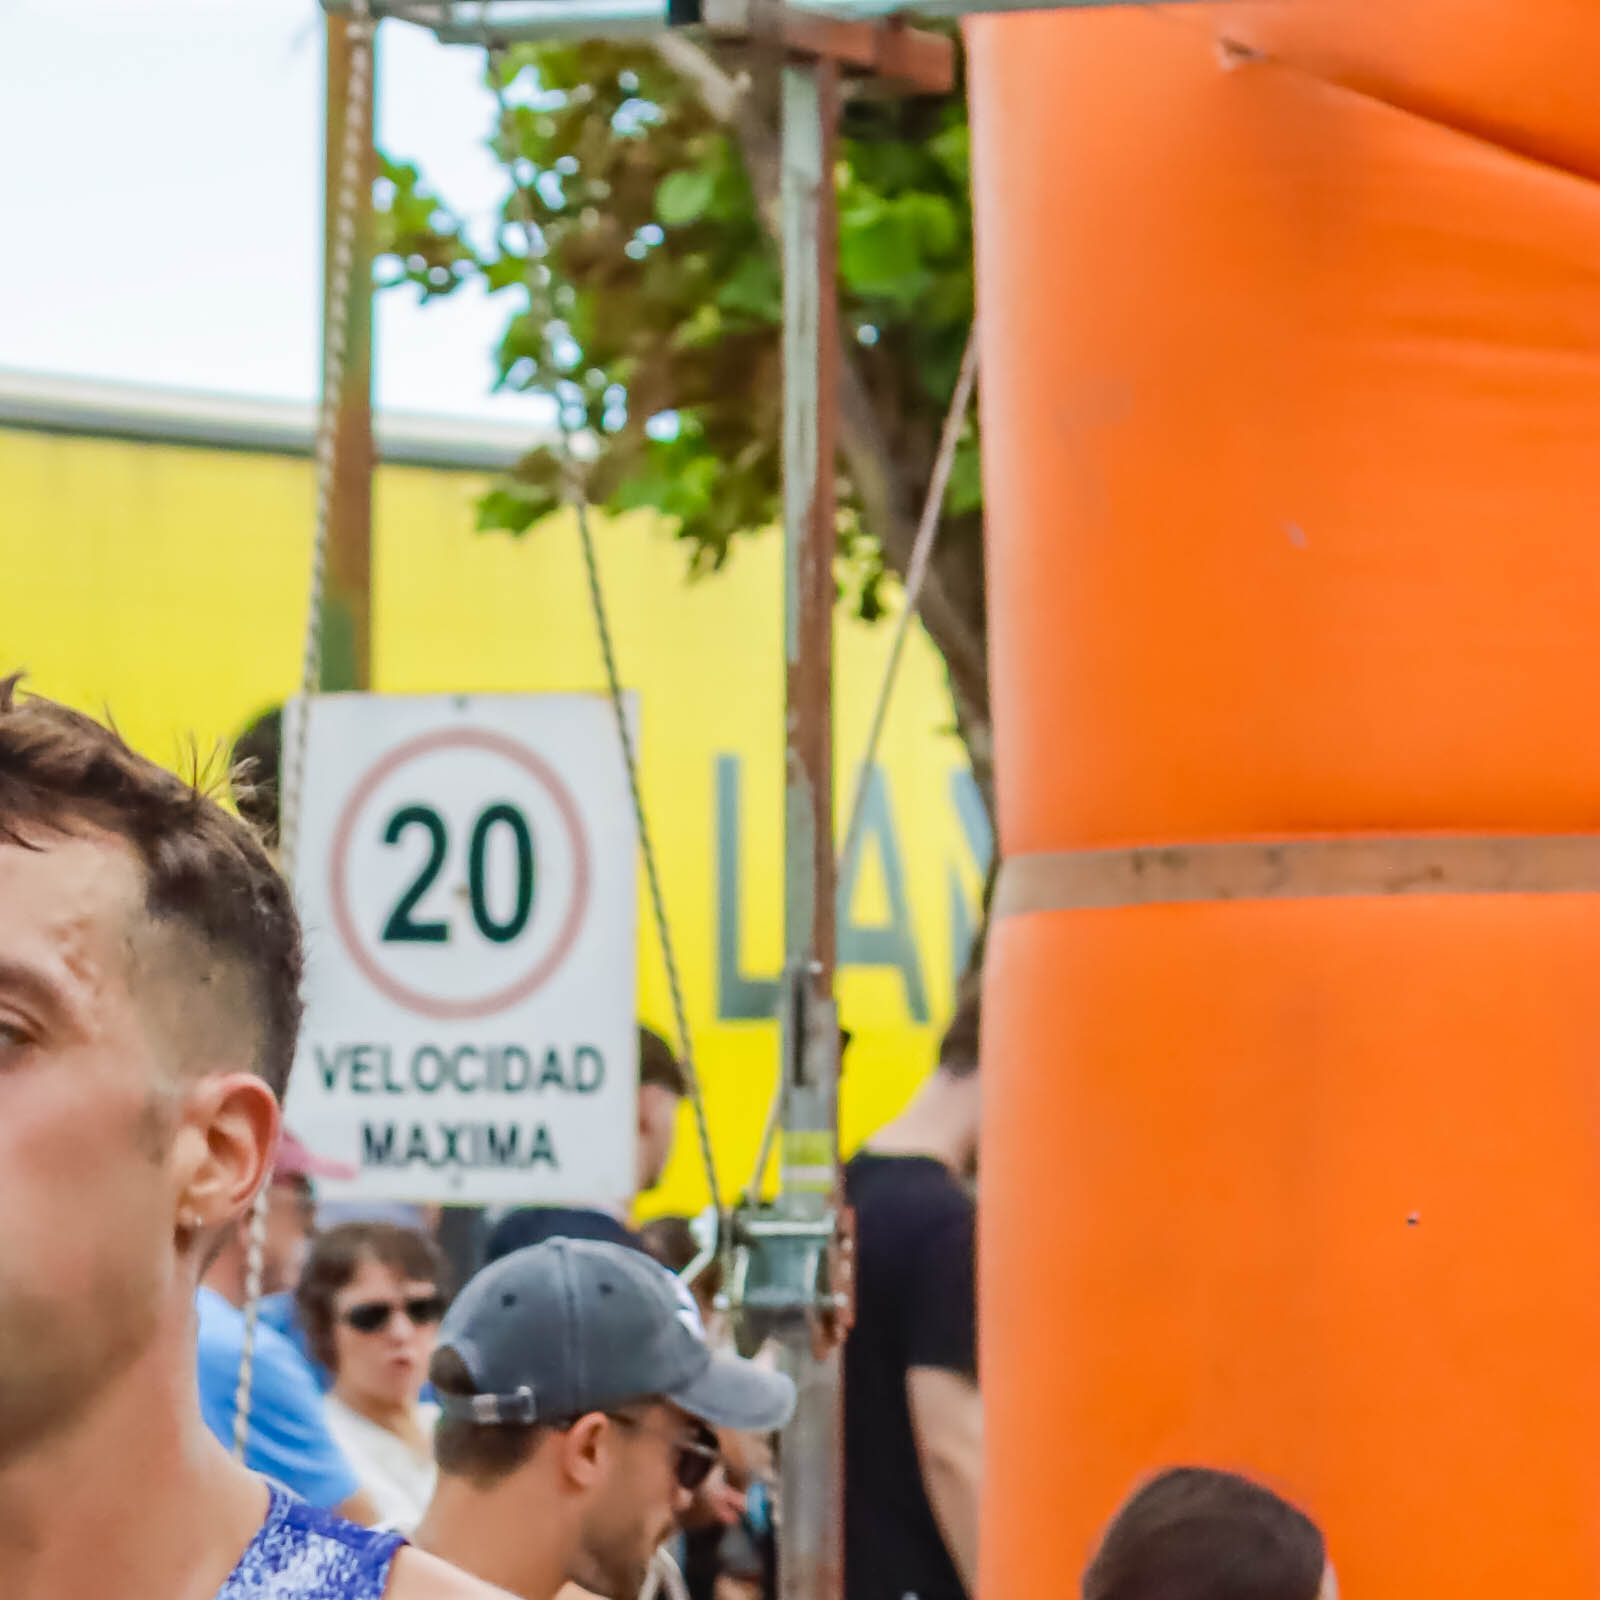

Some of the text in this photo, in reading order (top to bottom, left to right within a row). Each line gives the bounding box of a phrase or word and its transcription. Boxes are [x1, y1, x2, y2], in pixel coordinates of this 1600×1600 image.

[382, 804, 535, 942] 20
[314, 1044, 606, 1094] VELOCIDAD
[360, 1122, 560, 1171] MAXIMA
